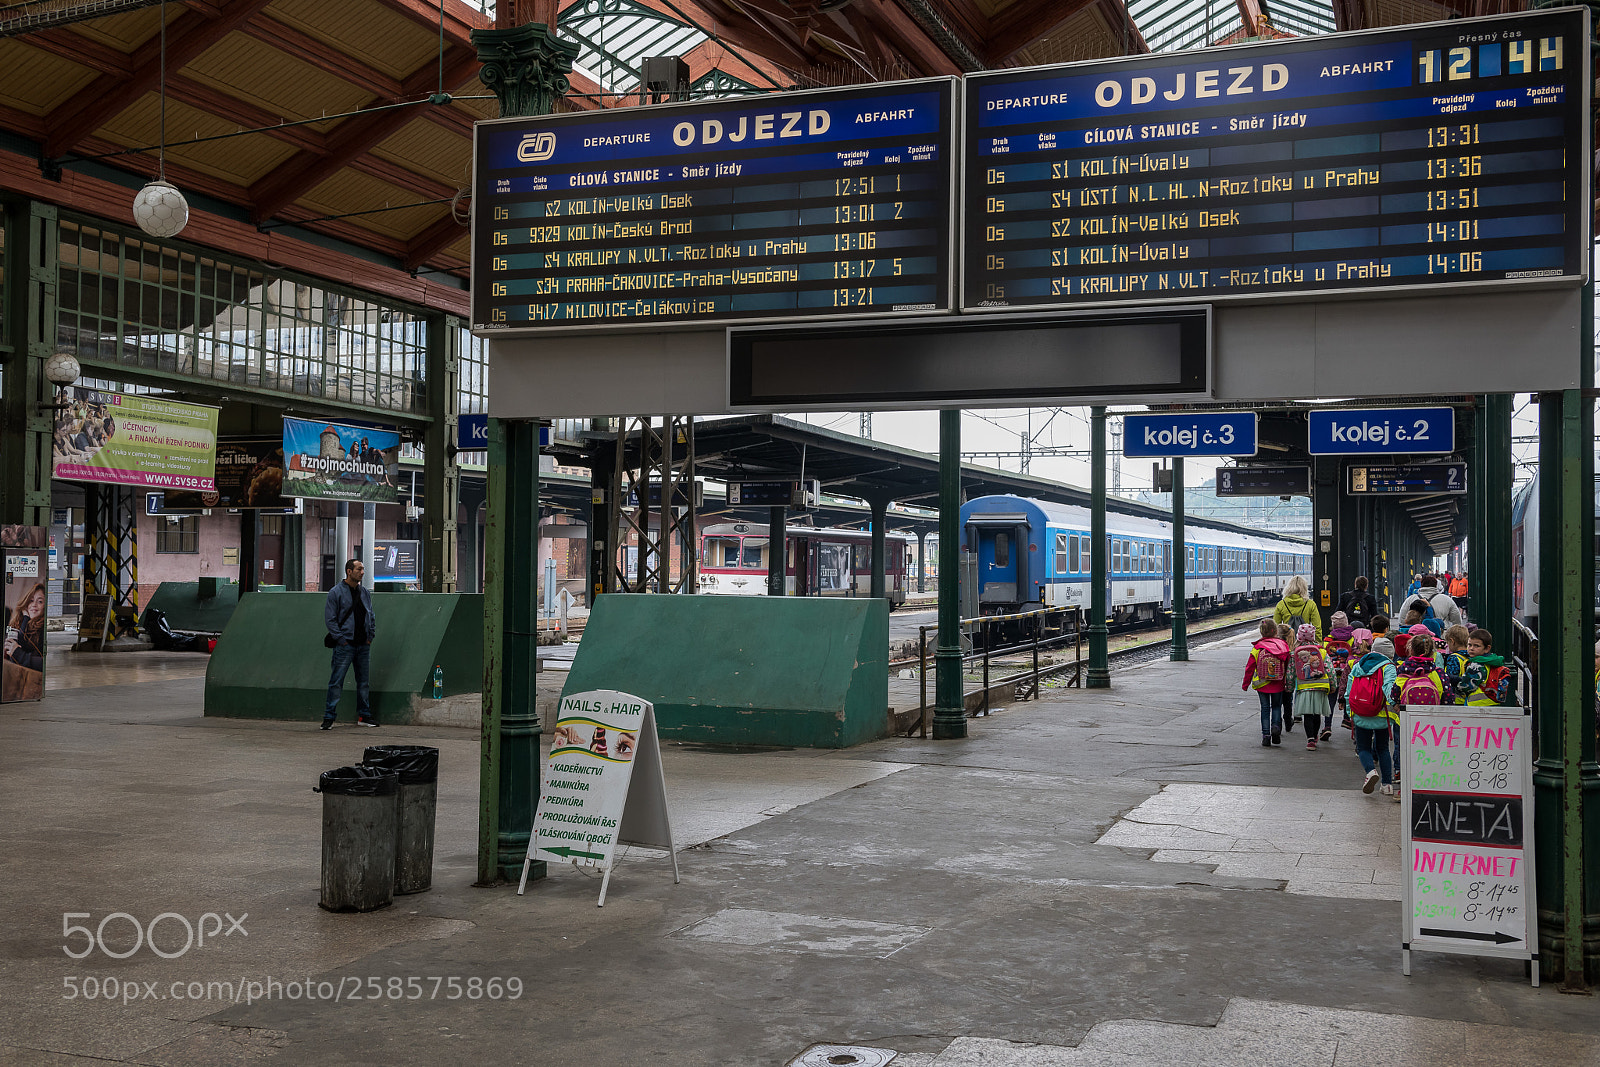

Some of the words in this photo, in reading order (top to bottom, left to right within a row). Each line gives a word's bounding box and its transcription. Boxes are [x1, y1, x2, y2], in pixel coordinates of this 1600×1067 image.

[1458, 31, 1498, 44] Přesný
[1502, 30, 1522, 40] čas
[1419, 46, 1472, 83] 12
[1509, 36, 1564, 74] 44
[986, 93, 1068, 111] DEPARTURE
[1094, 63, 1289, 108] ODJEZD
[1320, 60, 1394, 78] ABFAHRT
[1526, 85, 1564, 97] Zpoždění
[1432, 93, 1475, 106] Pravidelný
[1440, 102, 1467, 113] odjezd
[1496, 98, 1517, 109] Kolej
[1533, 94, 1558, 104] minut
[584, 133, 651, 148] DEPARTURE
[672, 110, 831, 147] ODJEZD
[855, 108, 915, 124] ABFAHRT
[1084, 124, 1134, 144] CÍLOVÁ
[1141, 121, 1200, 139] STANICE
[1230, 115, 1265, 132] Směr
[1272, 112, 1308, 130] jízdy
[992, 138, 1009, 146] Druh
[1038, 132, 1056, 142] Číslo
[1038, 140, 1057, 149] vlaku
[837, 150, 870, 160] Pravidelný
[908, 145, 936, 154] Zpoždění
[912, 152, 931, 161] minut
[987, 168, 1005, 185] Os
[1052, 160, 1069, 180] S1
[1080, 152, 1189, 177] KOLÍN-Úvaly
[1427, 123, 1480, 148] 13:31
[991, 145, 1010, 154] vlaku
[843, 158, 864, 167] odjezd
[884, 155, 901, 164] Kolej
[569, 171, 608, 187] CÍLOVÁ
[613, 168, 660, 184] STANICE
[682, 164, 710, 178] Směr
[715, 162, 743, 178] jízdy
[986, 197, 1005, 214] Os
[1052, 190, 1071, 209] S4
[1080, 185, 1117, 206] ÚSTÍ
[1304, 174, 1314, 190] u
[1324, 167, 1380, 188] Prahy
[1426, 155, 1482, 180] 13:36
[494, 206, 510, 220] Os
[546, 200, 561, 218] S2
[568, 194, 653, 216] KOLÍN-Velký
[660, 193, 693, 210] Osek
[835, 176, 875, 196] 12:51
[896, 174, 902, 192] 1
[986, 226, 1004, 242] Os
[1052, 218, 1071, 238] S2
[1080, 212, 1189, 236] KOLÍN-Velký
[1199, 209, 1240, 228] Osek
[1426, 188, 1479, 212] 13:51
[493, 232, 508, 246] Os
[529, 226, 561, 244] 9329
[567, 220, 653, 242] KOLÍN-Český
[660, 219, 693, 236] Brod
[834, 203, 875, 224] 13:01
[894, 202, 903, 220] 2
[492, 257, 508, 271] Os
[544, 251, 560, 268] S4
[566, 250, 622, 267] KRALUPY
[748, 244, 758, 256] u
[765, 240, 808, 256] Prahy
[834, 231, 876, 252] 13:06
[986, 254, 1004, 270] Os
[1052, 248, 1068, 267] S1
[1080, 242, 1189, 266] KOLÍN-Úvaly
[1426, 219, 1479, 243] 14:01
[492, 282, 508, 297] Os
[536, 278, 560, 295] S34
[566, 268, 799, 294] PRAHA-ČAKOVICE-Praha-Vysočany
[834, 259, 876, 280] 13:17
[892, 258, 903, 276] 5
[986, 283, 1004, 299] Os
[1052, 277, 1071, 296] S4
[1080, 274, 1149, 294] KRALUPY
[1314, 267, 1325, 281] u
[1336, 261, 1392, 280] Prahy
[1426, 251, 1482, 275] 14:06
[492, 308, 507, 322] Os
[528, 303, 560, 321] 9417
[566, 299, 716, 320] MILOVICE-Čelákovice
[833, 287, 874, 307] 13:21
[122, 420, 158, 434] ÚČETNICTVÍ
[1332, 420, 1390, 446] kolej
[1395, 420, 1430, 441] č.2
[134, 432, 165, 444] FINANČNÍ
[166, 437, 184, 448] ŘÍZENÍ
[184, 440, 210, 450] PODNIKU
[1144, 424, 1198, 449] kolej
[1202, 424, 1235, 445] č.3
[234, 454, 258, 464] líčka
[300, 453, 384, 475] #znojmochutna
[145, 473, 214, 489] www.svse.cz
[564, 699, 602, 713] NAILS
[604, 706, 609, 714] &
[610, 702, 642, 716] HAIR
[1411, 720, 1520, 751] KVĚTINY
[553, 762, 605, 776] KADEŘNICTVÍ
[549, 779, 590, 792] MANIKÚRA
[546, 795, 584, 808] PEDIKÚRA
[542, 811, 602, 827] PRODLUŽOVÁNÍ
[600, 816, 618, 828] ŘAS
[1414, 800, 1514, 840] ANETA
[538, 828, 586, 843] VLÁSKOVÁNÍ
[586, 833, 613, 846] OBOČÍ
[1414, 848, 1523, 878] INTERNET
